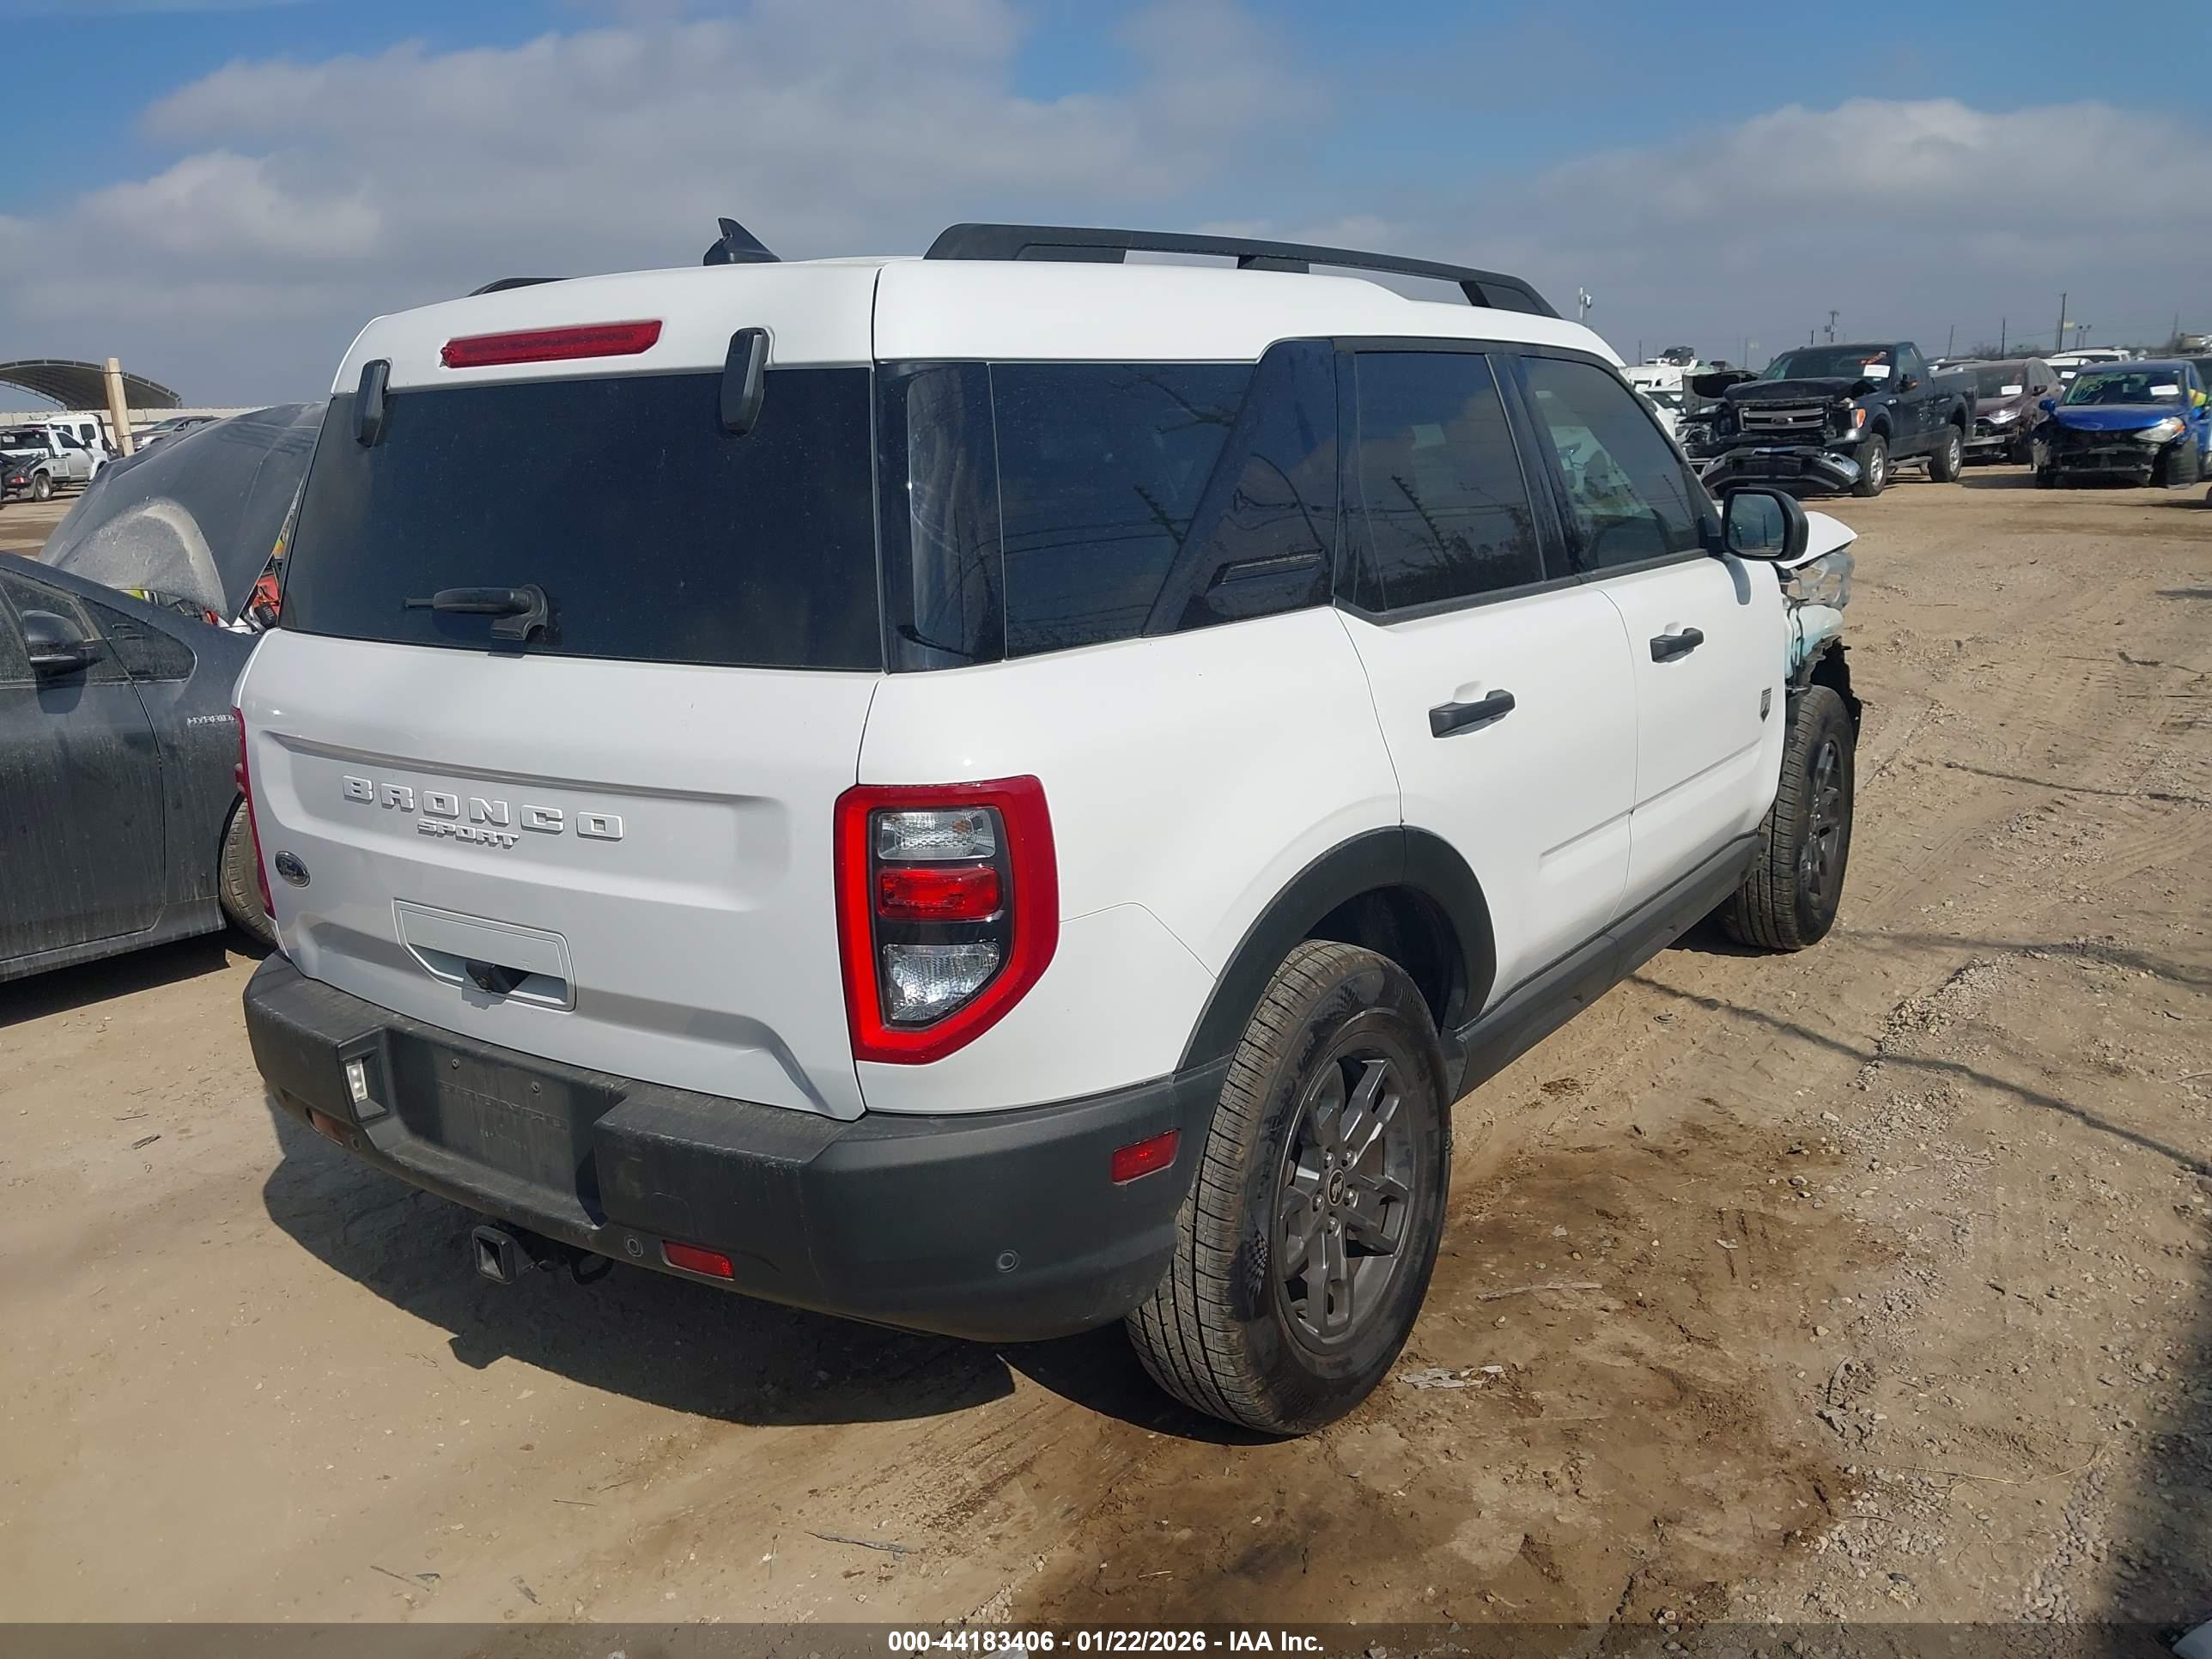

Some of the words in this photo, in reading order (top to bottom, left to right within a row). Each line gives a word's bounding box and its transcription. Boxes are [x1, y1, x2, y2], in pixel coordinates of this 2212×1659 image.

[186, 714, 235, 726] HYBRID
[343, 775, 625, 843] BRONCO
[417, 817, 520, 850] SPORT
